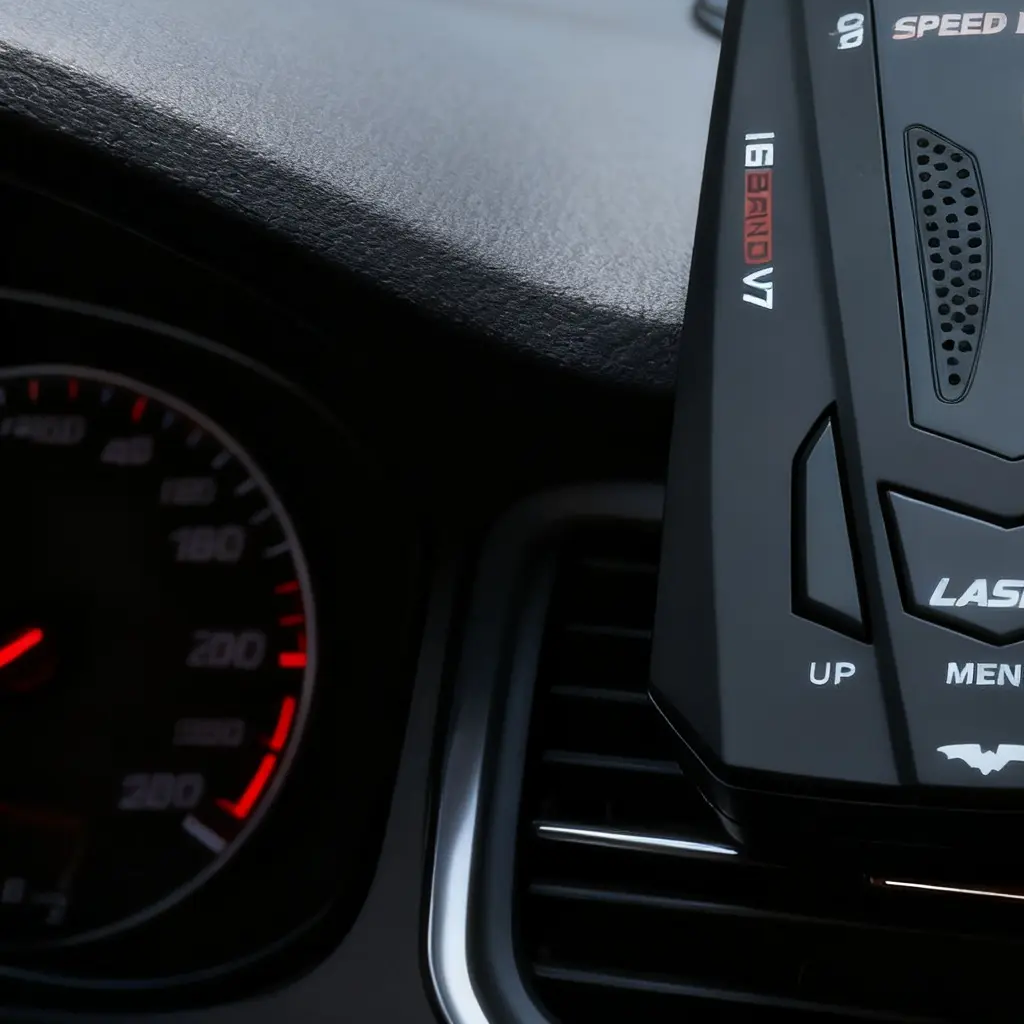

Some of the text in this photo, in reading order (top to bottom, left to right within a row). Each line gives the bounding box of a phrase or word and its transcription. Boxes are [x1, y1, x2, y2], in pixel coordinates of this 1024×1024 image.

[892, 11, 1007, 41] SPEED
[742, 267, 774, 310] V7
[809, 662, 857, 685] UP
